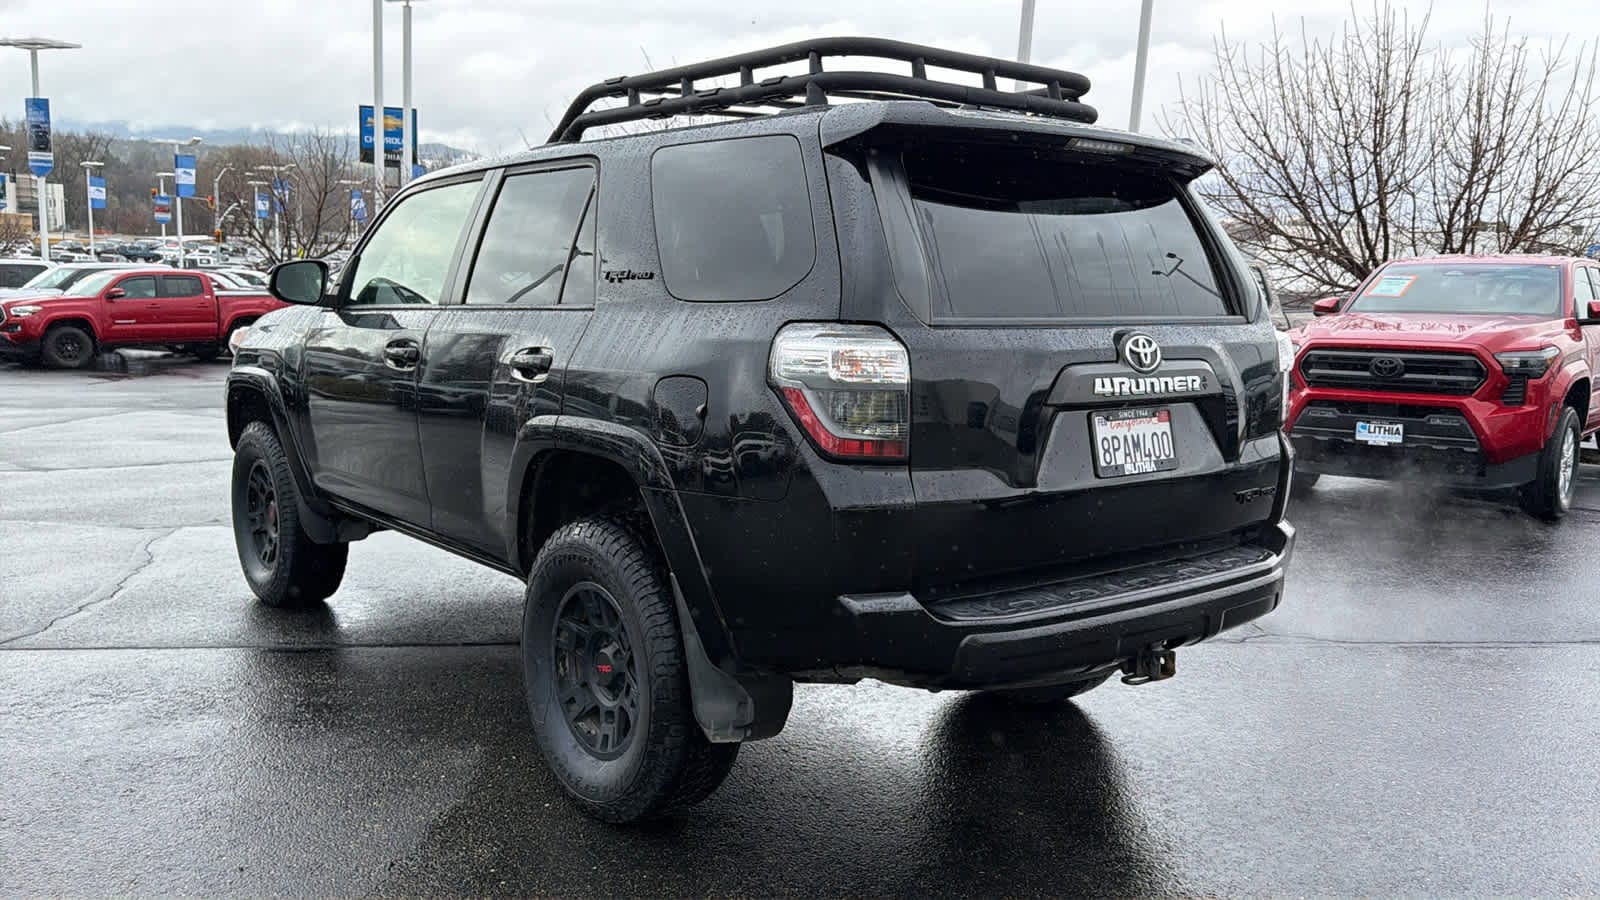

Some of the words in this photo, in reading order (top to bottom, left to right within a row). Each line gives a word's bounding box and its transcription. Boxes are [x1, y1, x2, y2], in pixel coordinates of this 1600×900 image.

[1094, 375, 1201, 397] 4RUNNER
[1118, 411, 1136, 419] SINCE
[1368, 424, 1402, 436] LITHIA
[1101, 431, 1171, 465] 8PAM400
